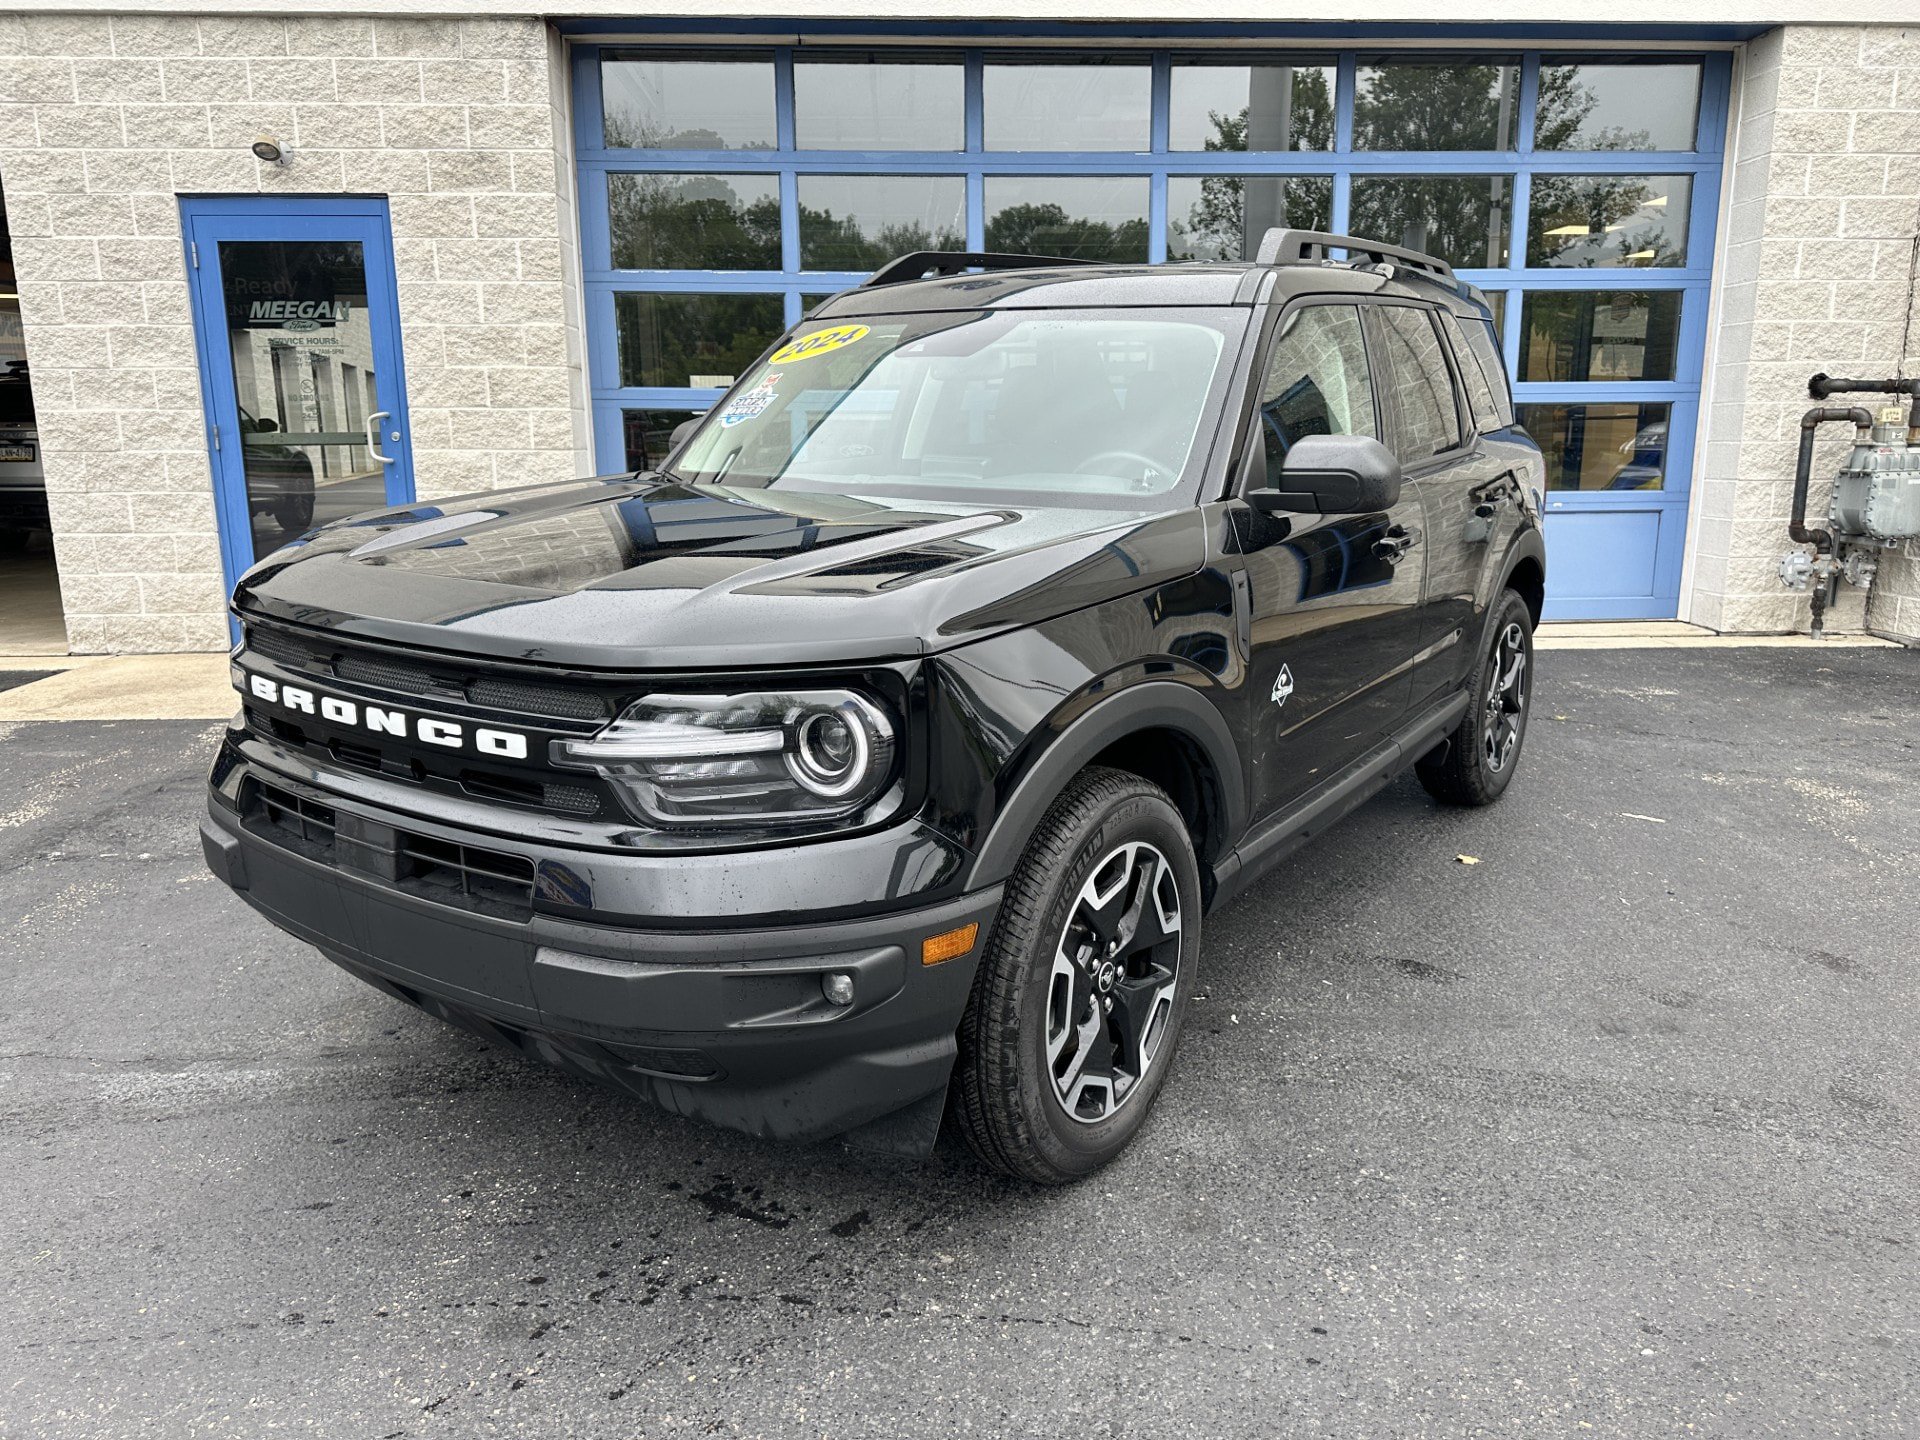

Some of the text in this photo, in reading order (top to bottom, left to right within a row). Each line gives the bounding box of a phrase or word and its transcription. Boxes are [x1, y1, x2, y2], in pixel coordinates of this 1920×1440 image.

[235, 277, 298, 297] Ready
[249, 301, 351, 319] MEEGAN
[289, 320, 314, 329] Ford
[267, 337, 339, 345] SERVICE HOURS:
[775, 327, 864, 361] 2024
[250, 674, 528, 759] BRONCO
[1051, 832, 1103, 929] MICHELIN
